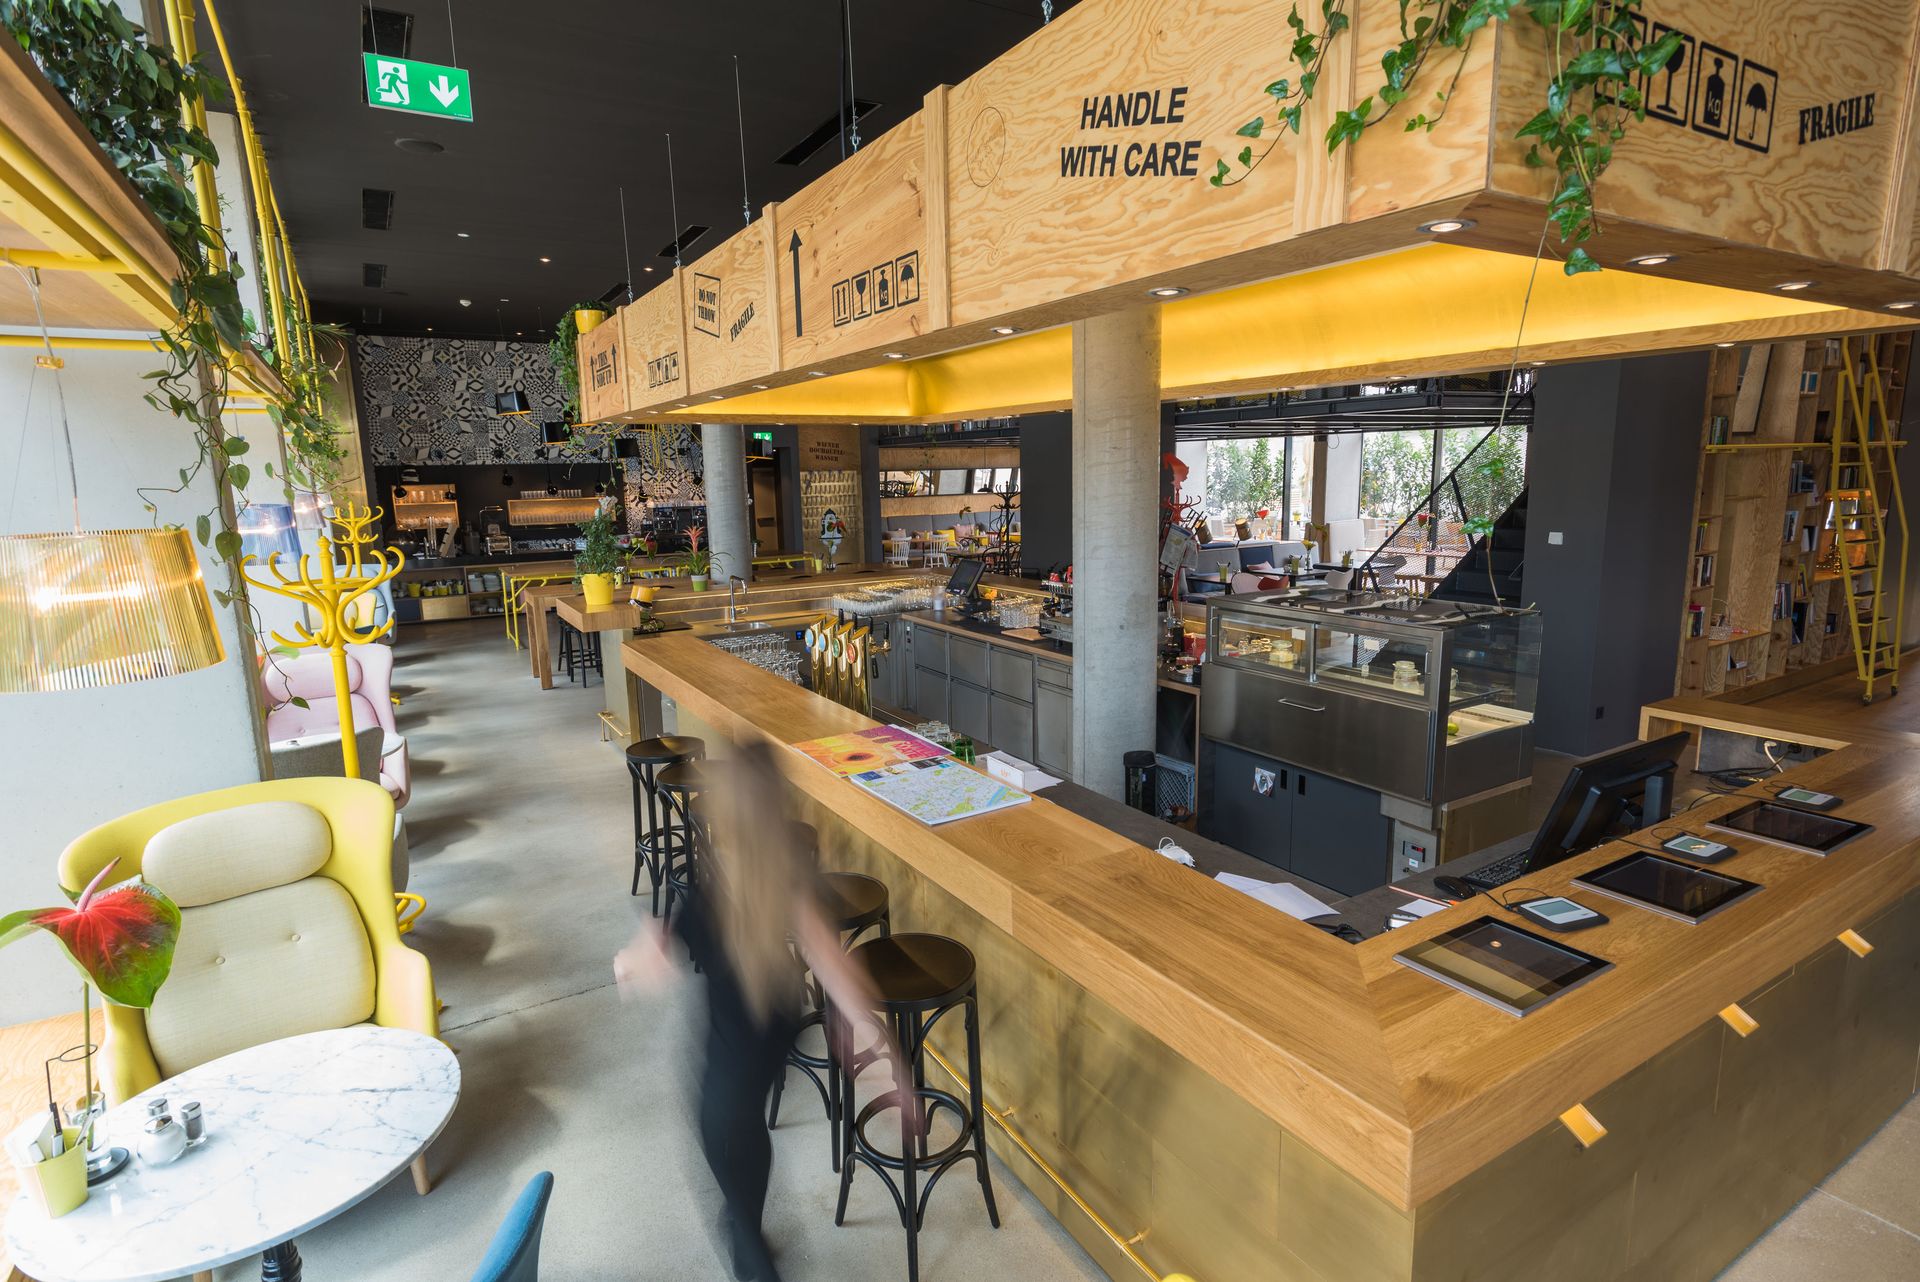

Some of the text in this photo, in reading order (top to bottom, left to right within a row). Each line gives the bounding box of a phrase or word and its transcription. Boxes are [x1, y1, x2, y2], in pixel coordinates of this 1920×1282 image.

[1080, 86, 1189, 130] HANDLE
[1708, 90, 1721, 120] kg
[1798, 93, 1876, 145] FRAGILE
[1060, 140, 1202, 178] WITH CARE
[698, 288, 717, 306] DO NOT
[697, 305, 716, 324] THROW
[730, 301, 755, 342] FRAGILE
[597, 350, 609, 368] THIS
[606, 369, 612, 385] UP
